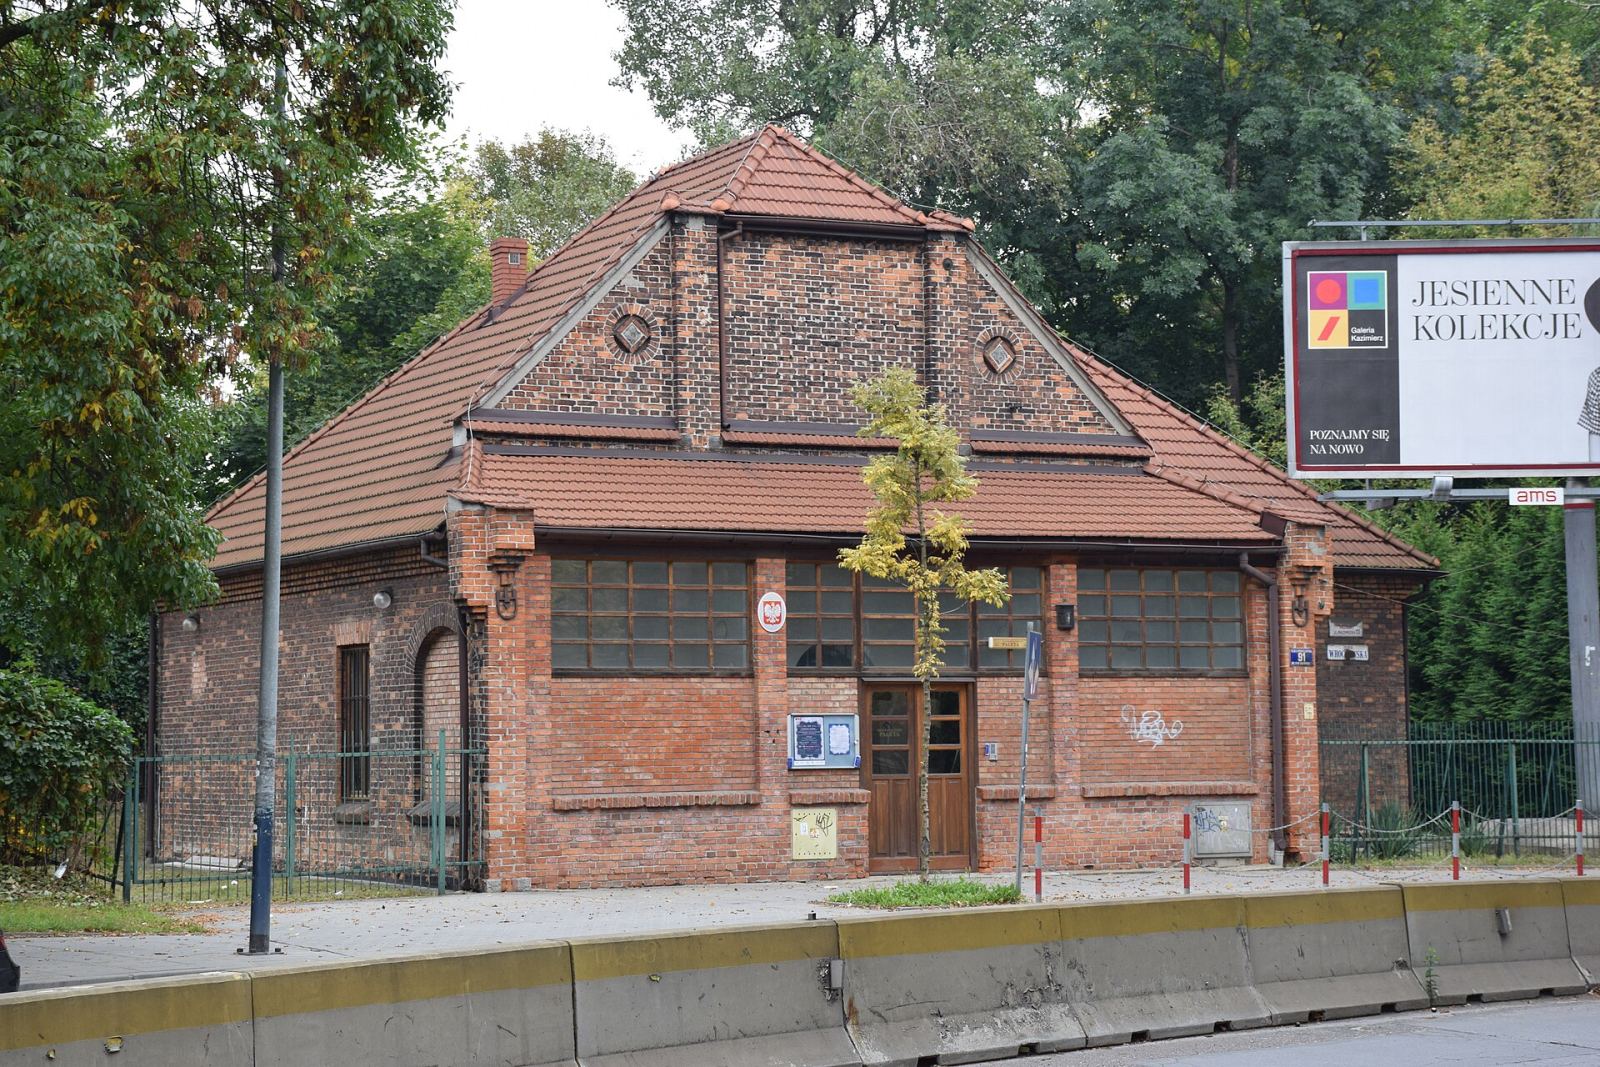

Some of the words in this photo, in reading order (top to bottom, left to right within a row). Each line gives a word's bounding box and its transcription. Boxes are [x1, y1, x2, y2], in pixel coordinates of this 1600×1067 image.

[1412, 279, 1576, 307] JESIENNE
[1350, 326, 1375, 334] Galeria
[1412, 313, 1582, 341] KOLEKCJE
[1350, 334, 1384, 342] Kazimierz
[1309, 429, 1370, 440] POZNAJMY
[1371, 429, 1390, 442] SIĘ
[1309, 444, 1327, 455] NA
[1328, 444, 1364, 455] NOWO
[1516, 490, 1557, 503] ams
[1297, 652, 1306, 662] 91
